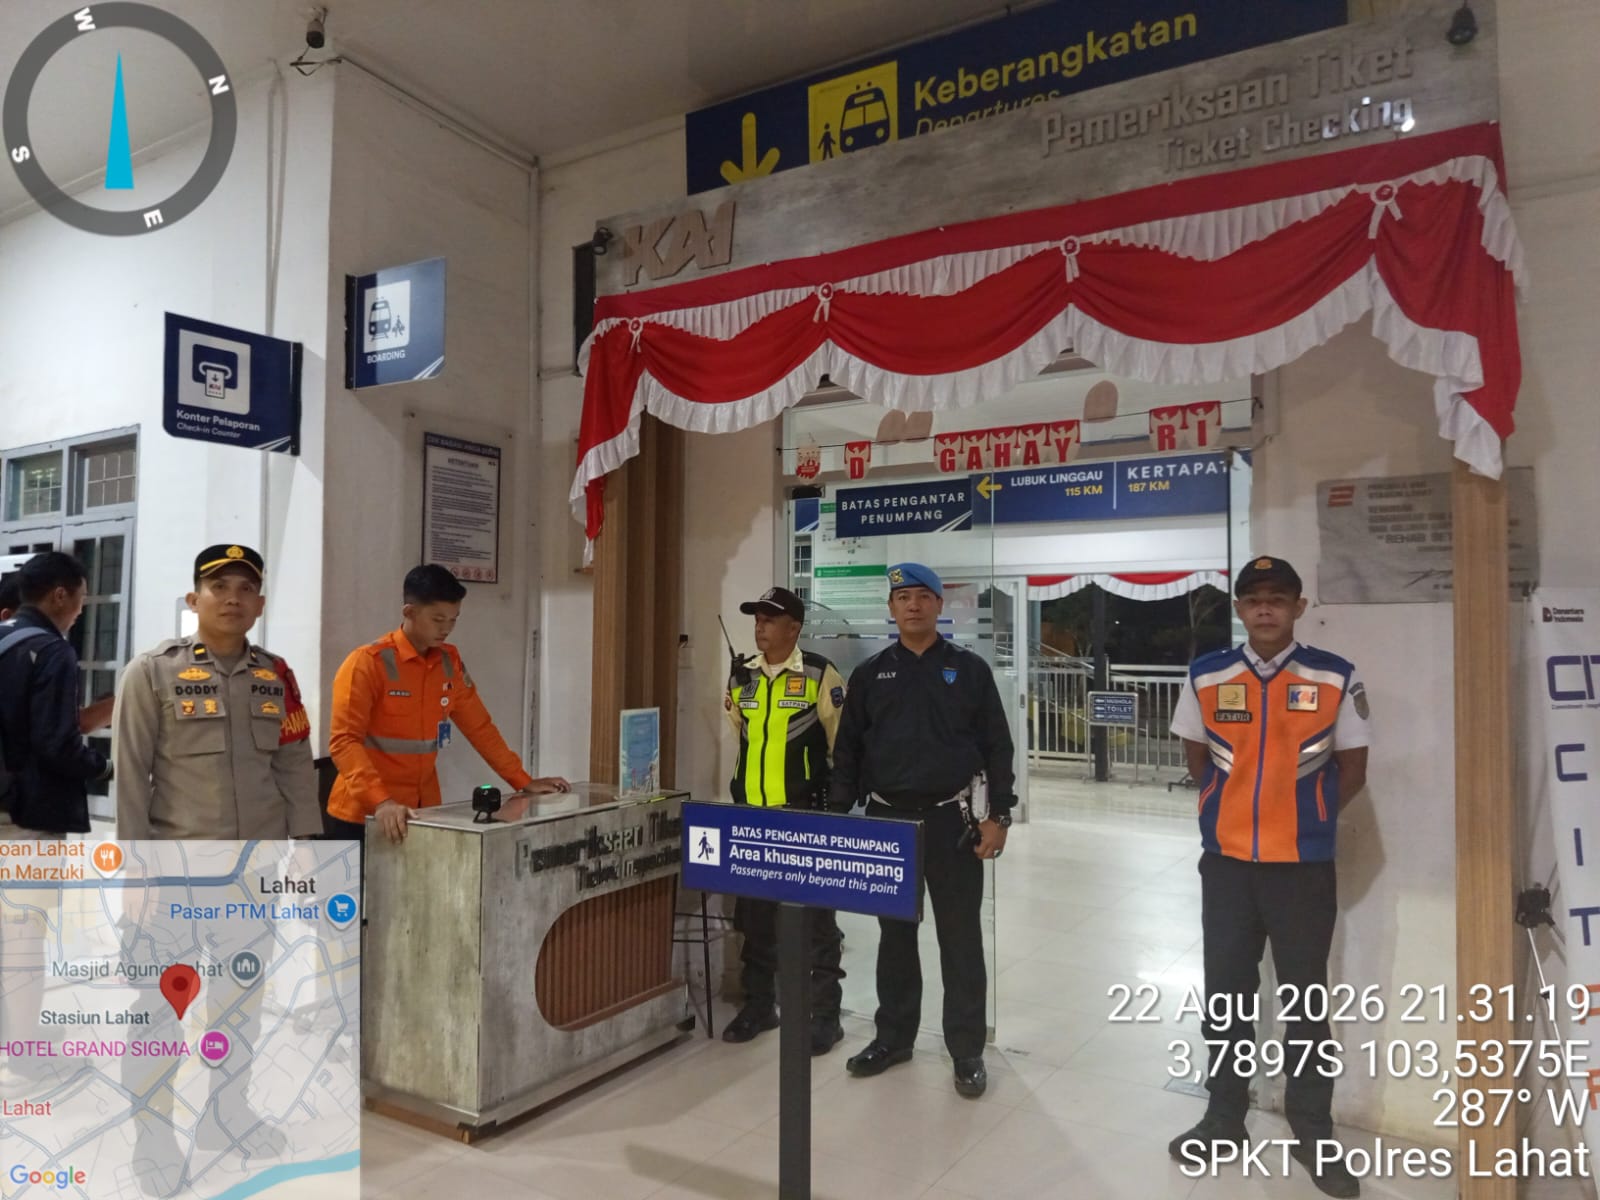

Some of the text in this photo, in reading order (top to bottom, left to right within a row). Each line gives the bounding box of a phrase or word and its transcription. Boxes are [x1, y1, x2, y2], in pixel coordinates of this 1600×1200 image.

[914, 11, 1197, 111] Keberangkatan
[1041, 37, 1414, 159] Pemeriksaan Tiket
[1159, 96, 1416, 173] Ticket Checking
[367, 349, 406, 364] BOARDING
[176, 409, 261, 432] Konter Pelaporan
[177, 421, 241, 439] Check-in Counter
[1011, 470, 1103, 488] LUBUK LINGGAU
[1129, 480, 1170, 493] 187 KM
[1065, 485, 1103, 497] 115 KM
[842, 498, 880, 511] BATAS
[884, 492, 966, 507] PENGANTAR
[861, 510, 943, 525] PENUMPANG
[175, 685, 217, 696] DODDY
[251, 685, 283, 697] POLRI
[731, 825, 900, 854] BATAS PENGANTAR PENUMPANG
[729, 844, 904, 882] Area khusus penumpang
[730, 864, 898, 895] Passengers only beyond this point
